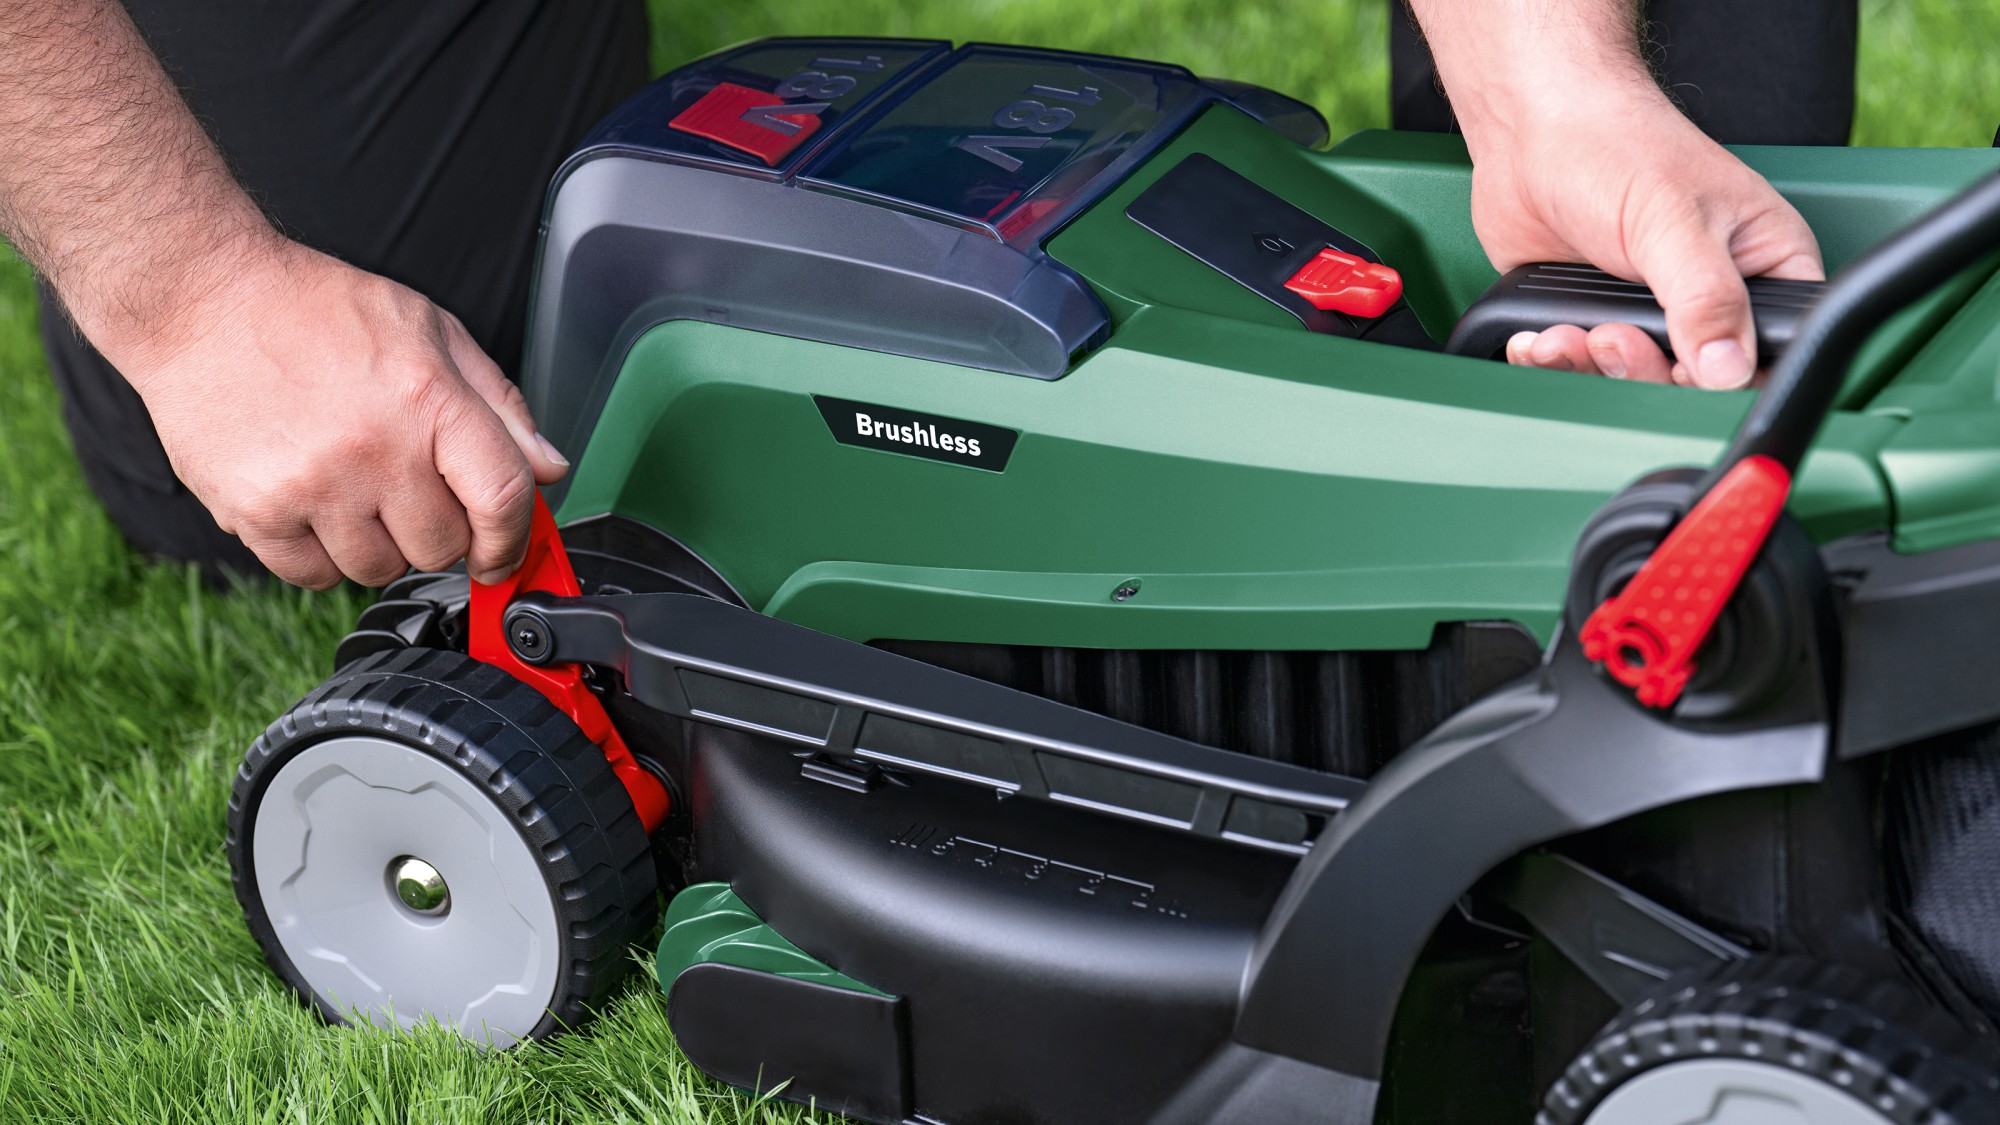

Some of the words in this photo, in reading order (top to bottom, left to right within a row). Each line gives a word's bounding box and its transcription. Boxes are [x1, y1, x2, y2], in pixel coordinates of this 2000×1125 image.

[738, 55, 885, 137] 18V
[955, 84, 1102, 173] 18V
[855, 412, 982, 457] Brushless
